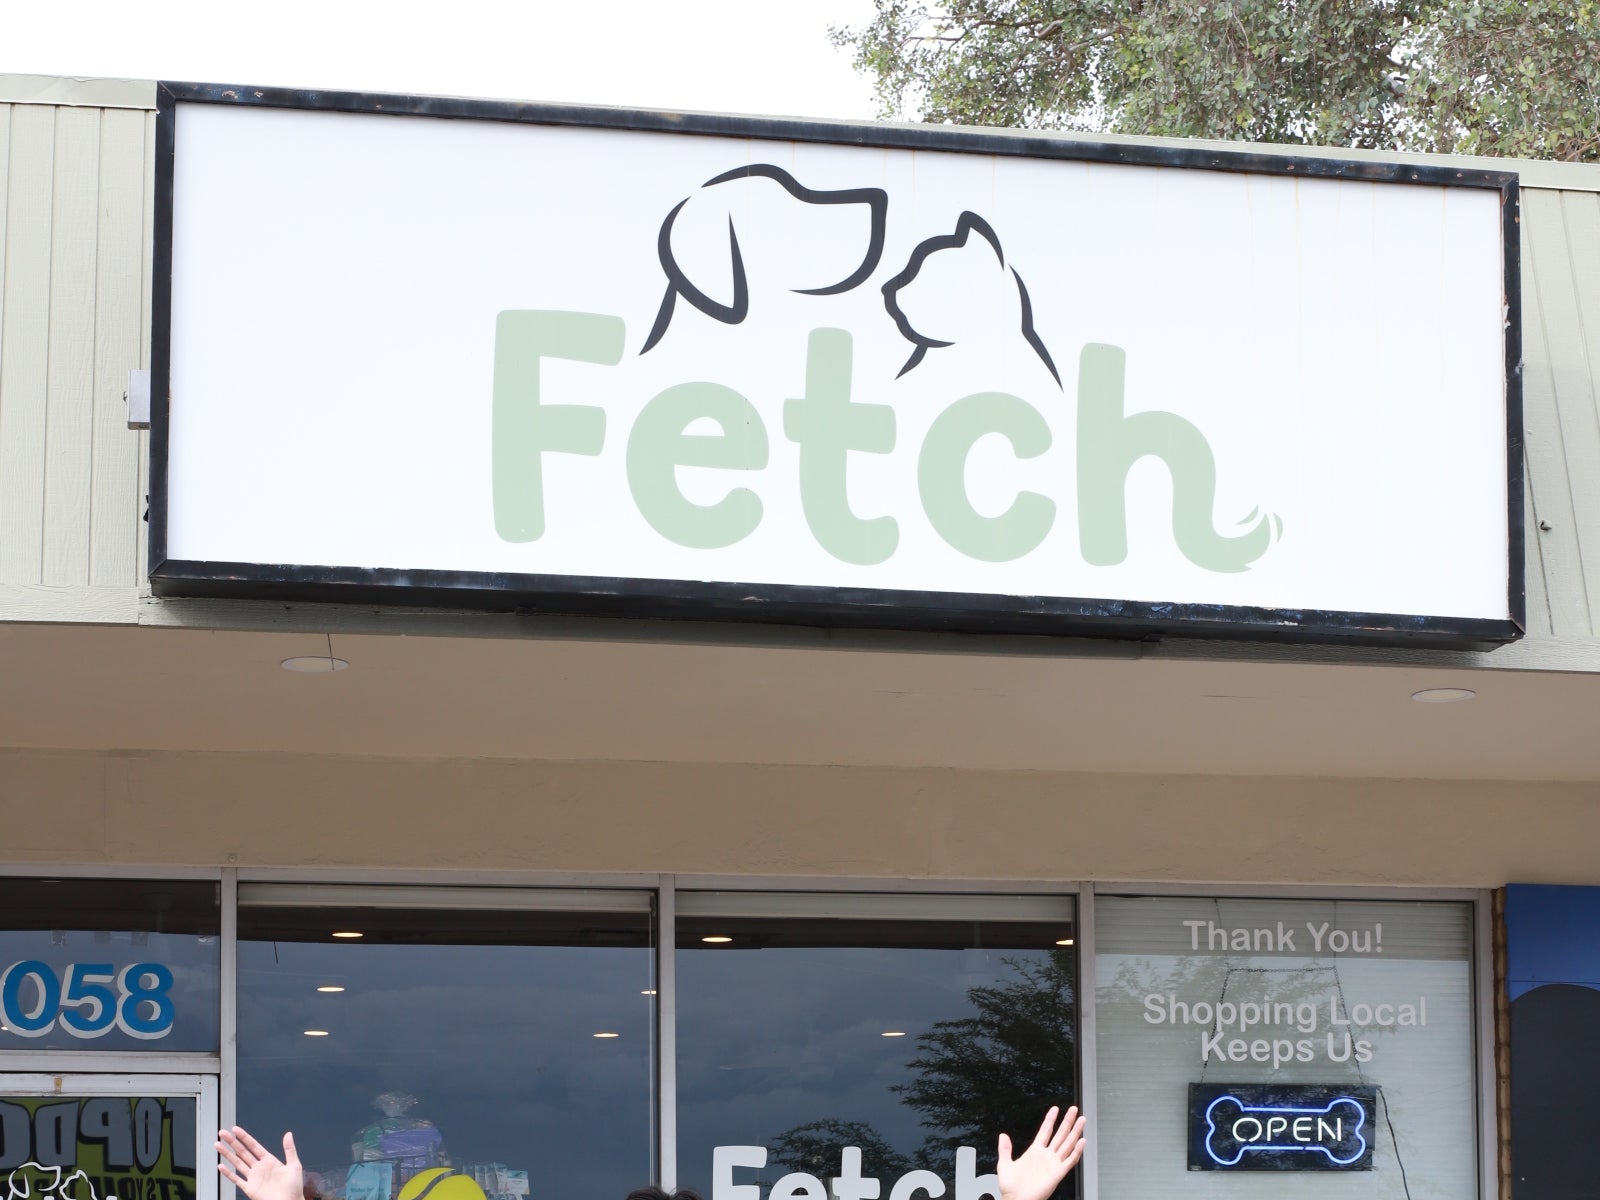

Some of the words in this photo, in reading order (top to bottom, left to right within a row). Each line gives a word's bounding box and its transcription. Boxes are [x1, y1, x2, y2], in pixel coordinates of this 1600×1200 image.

[492, 309, 1283, 574] Fetch
[1182, 920, 1296, 952] Thank
[1306, 921, 1383, 953] You!
[0, 960, 175, 1040] 058
[1143, 993, 1317, 1033] Shopping
[1330, 995, 1427, 1027] Local
[1200, 1030, 1315, 1070] Keeps
[1327, 1031, 1374, 1063] Us
[1232, 1116, 1343, 1143] OPEN
